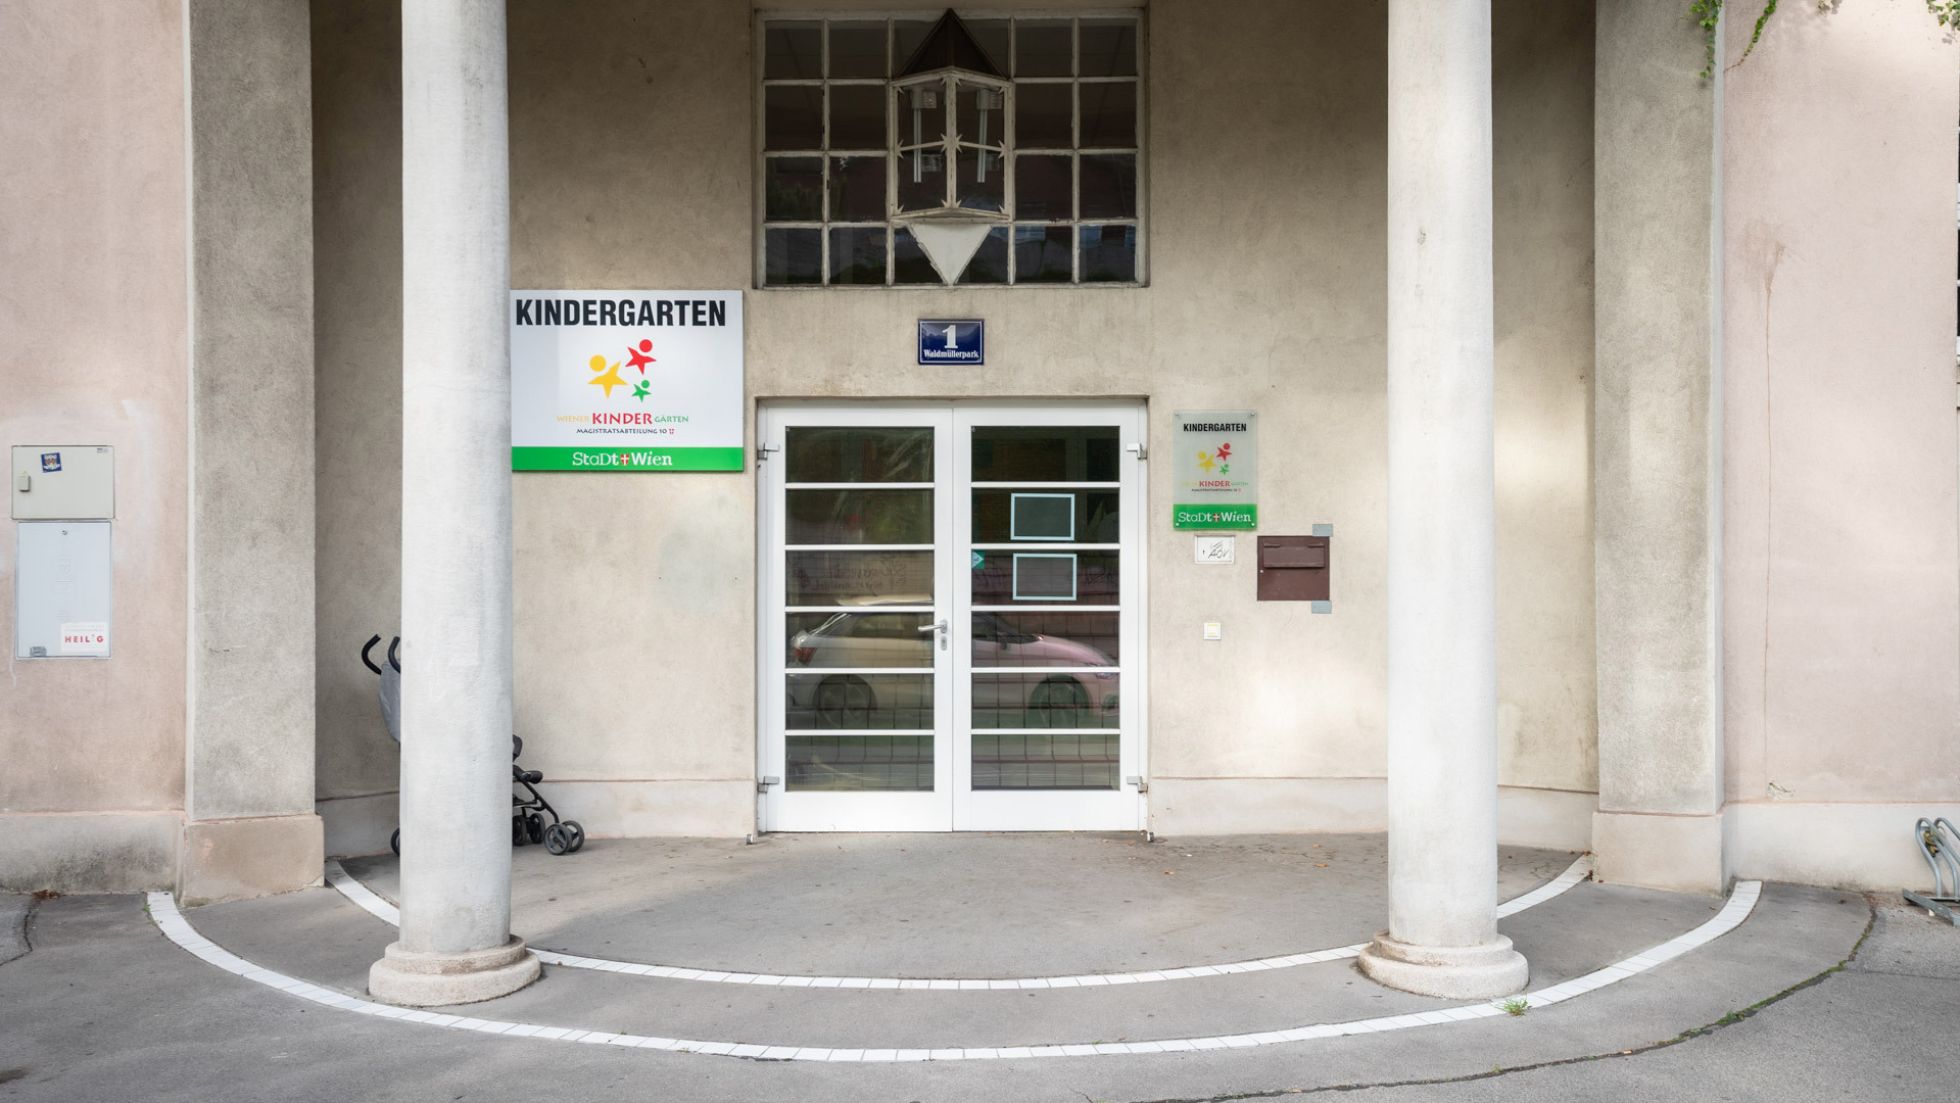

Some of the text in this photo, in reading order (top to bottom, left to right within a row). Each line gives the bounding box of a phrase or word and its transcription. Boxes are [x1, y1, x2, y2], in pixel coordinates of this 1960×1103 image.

[516, 299, 726, 326] KINDERGARTEN
[942, 325, 958, 349] 1
[923, 349, 979, 359] Waldmüllerpark
[592, 413, 652, 425] KINDER
[1183, 423, 1247, 432] KINDERGARTEN
[631, 452, 672, 466] Wien
[1220, 511, 1251, 522] Wien
